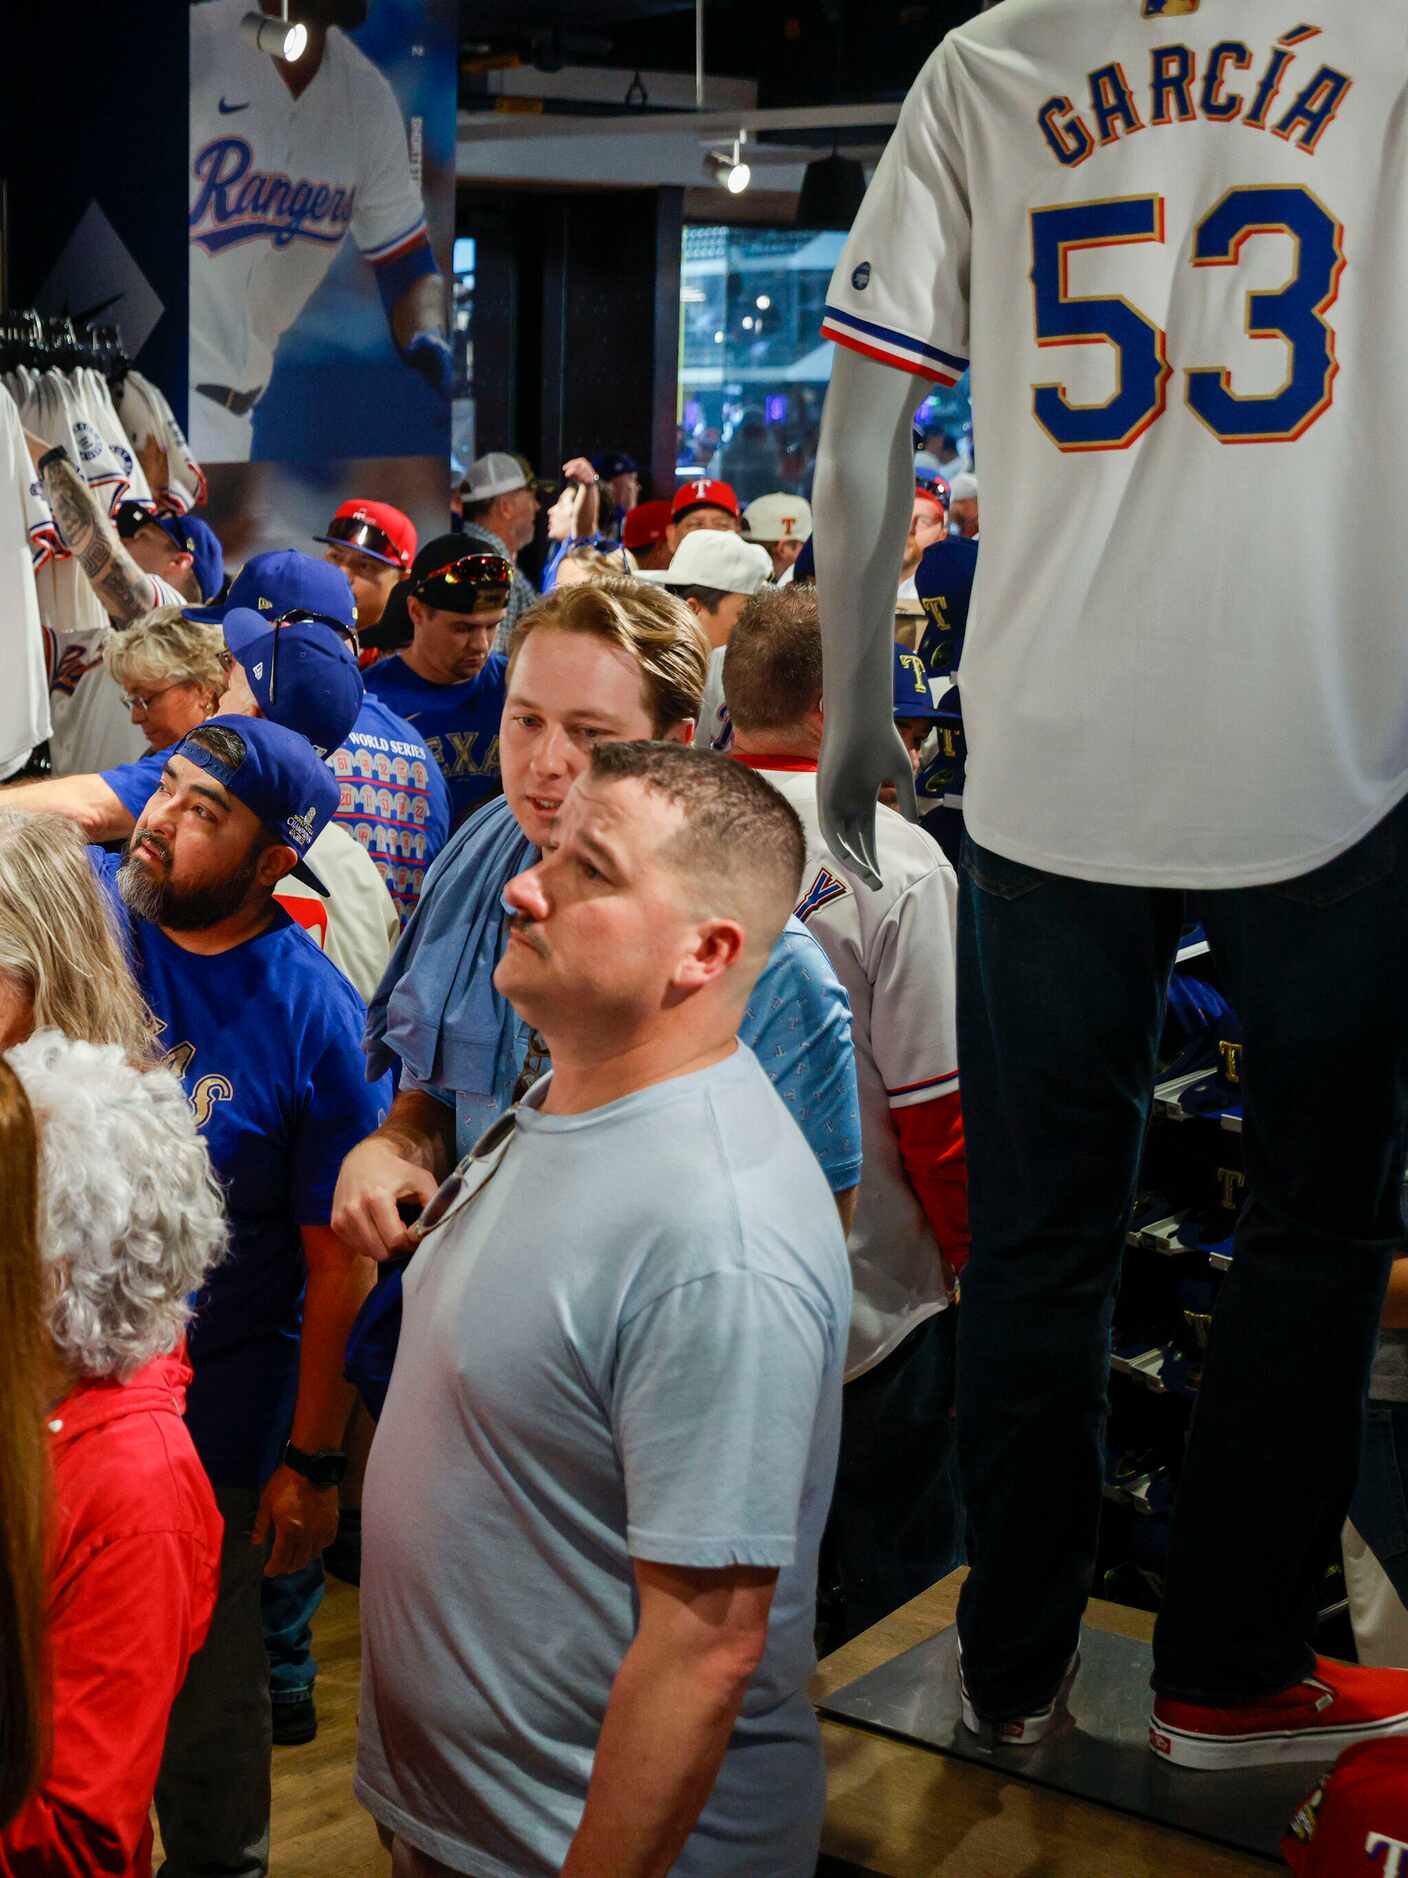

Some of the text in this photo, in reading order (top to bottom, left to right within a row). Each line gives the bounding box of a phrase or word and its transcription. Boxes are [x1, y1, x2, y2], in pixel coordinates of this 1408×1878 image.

[1037, 23, 1353, 168] GARCÍA
[1028, 183, 1347, 453] 53
[692, 478, 712, 499] T
[781, 517, 797, 536] T
[922, 597, 952, 631] T
[899, 654, 927, 693] T
[349, 732, 427, 760] WORLD SERIES
